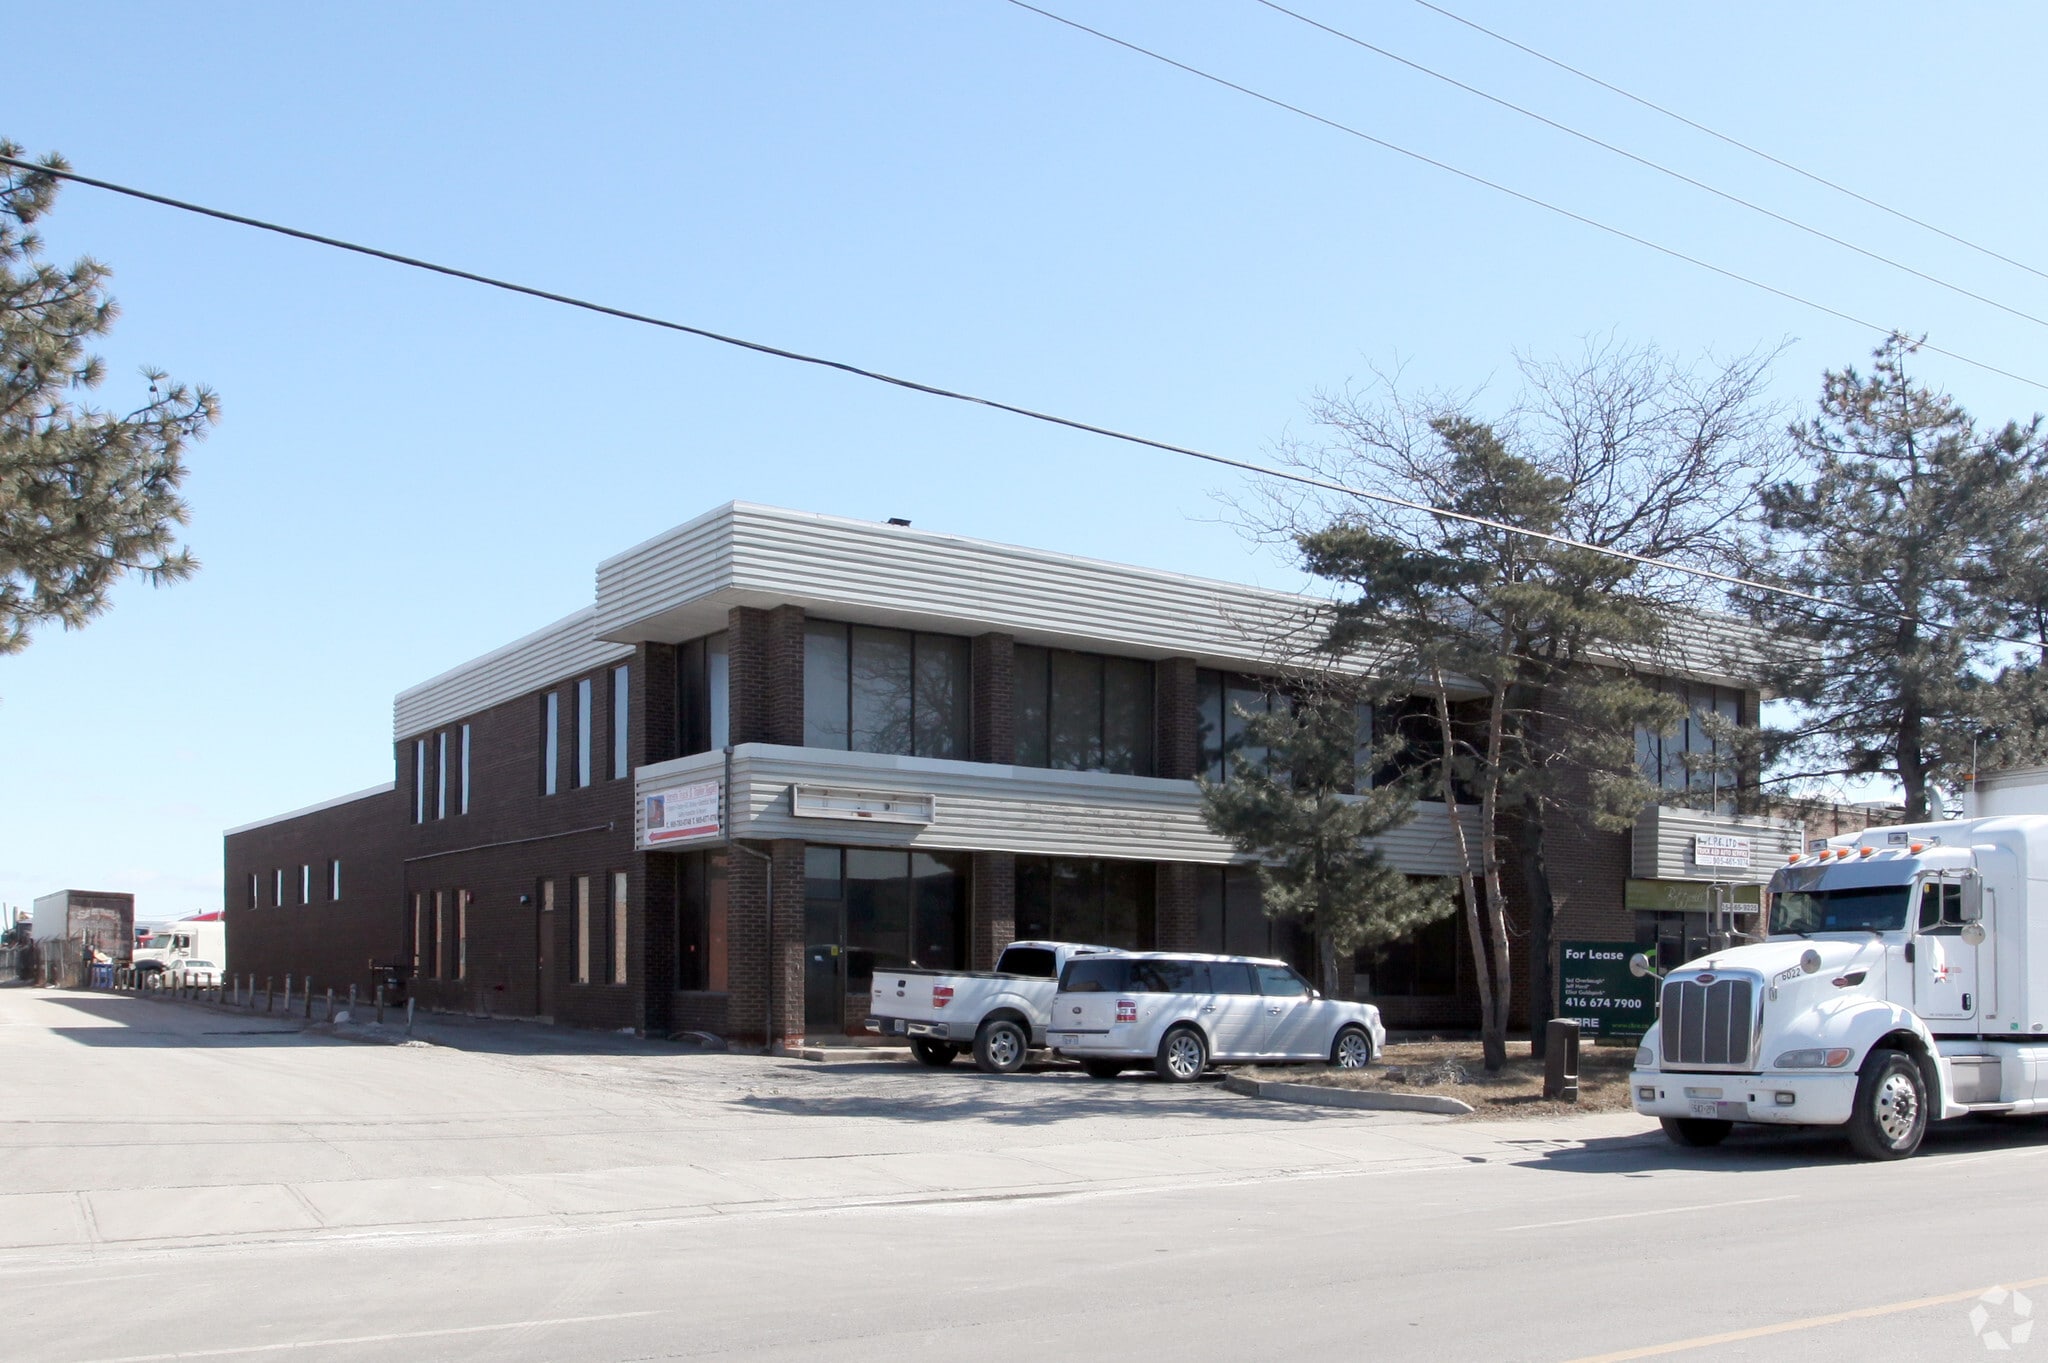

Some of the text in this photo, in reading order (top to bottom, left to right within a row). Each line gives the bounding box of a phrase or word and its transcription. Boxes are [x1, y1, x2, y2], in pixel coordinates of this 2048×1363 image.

[1565, 949, 1624, 960] For Lease
[1781, 967, 1801, 981] 6022
[1565, 997, 1642, 1009] 416 674 7900
[1569, 1017, 1600, 1028] BRE
